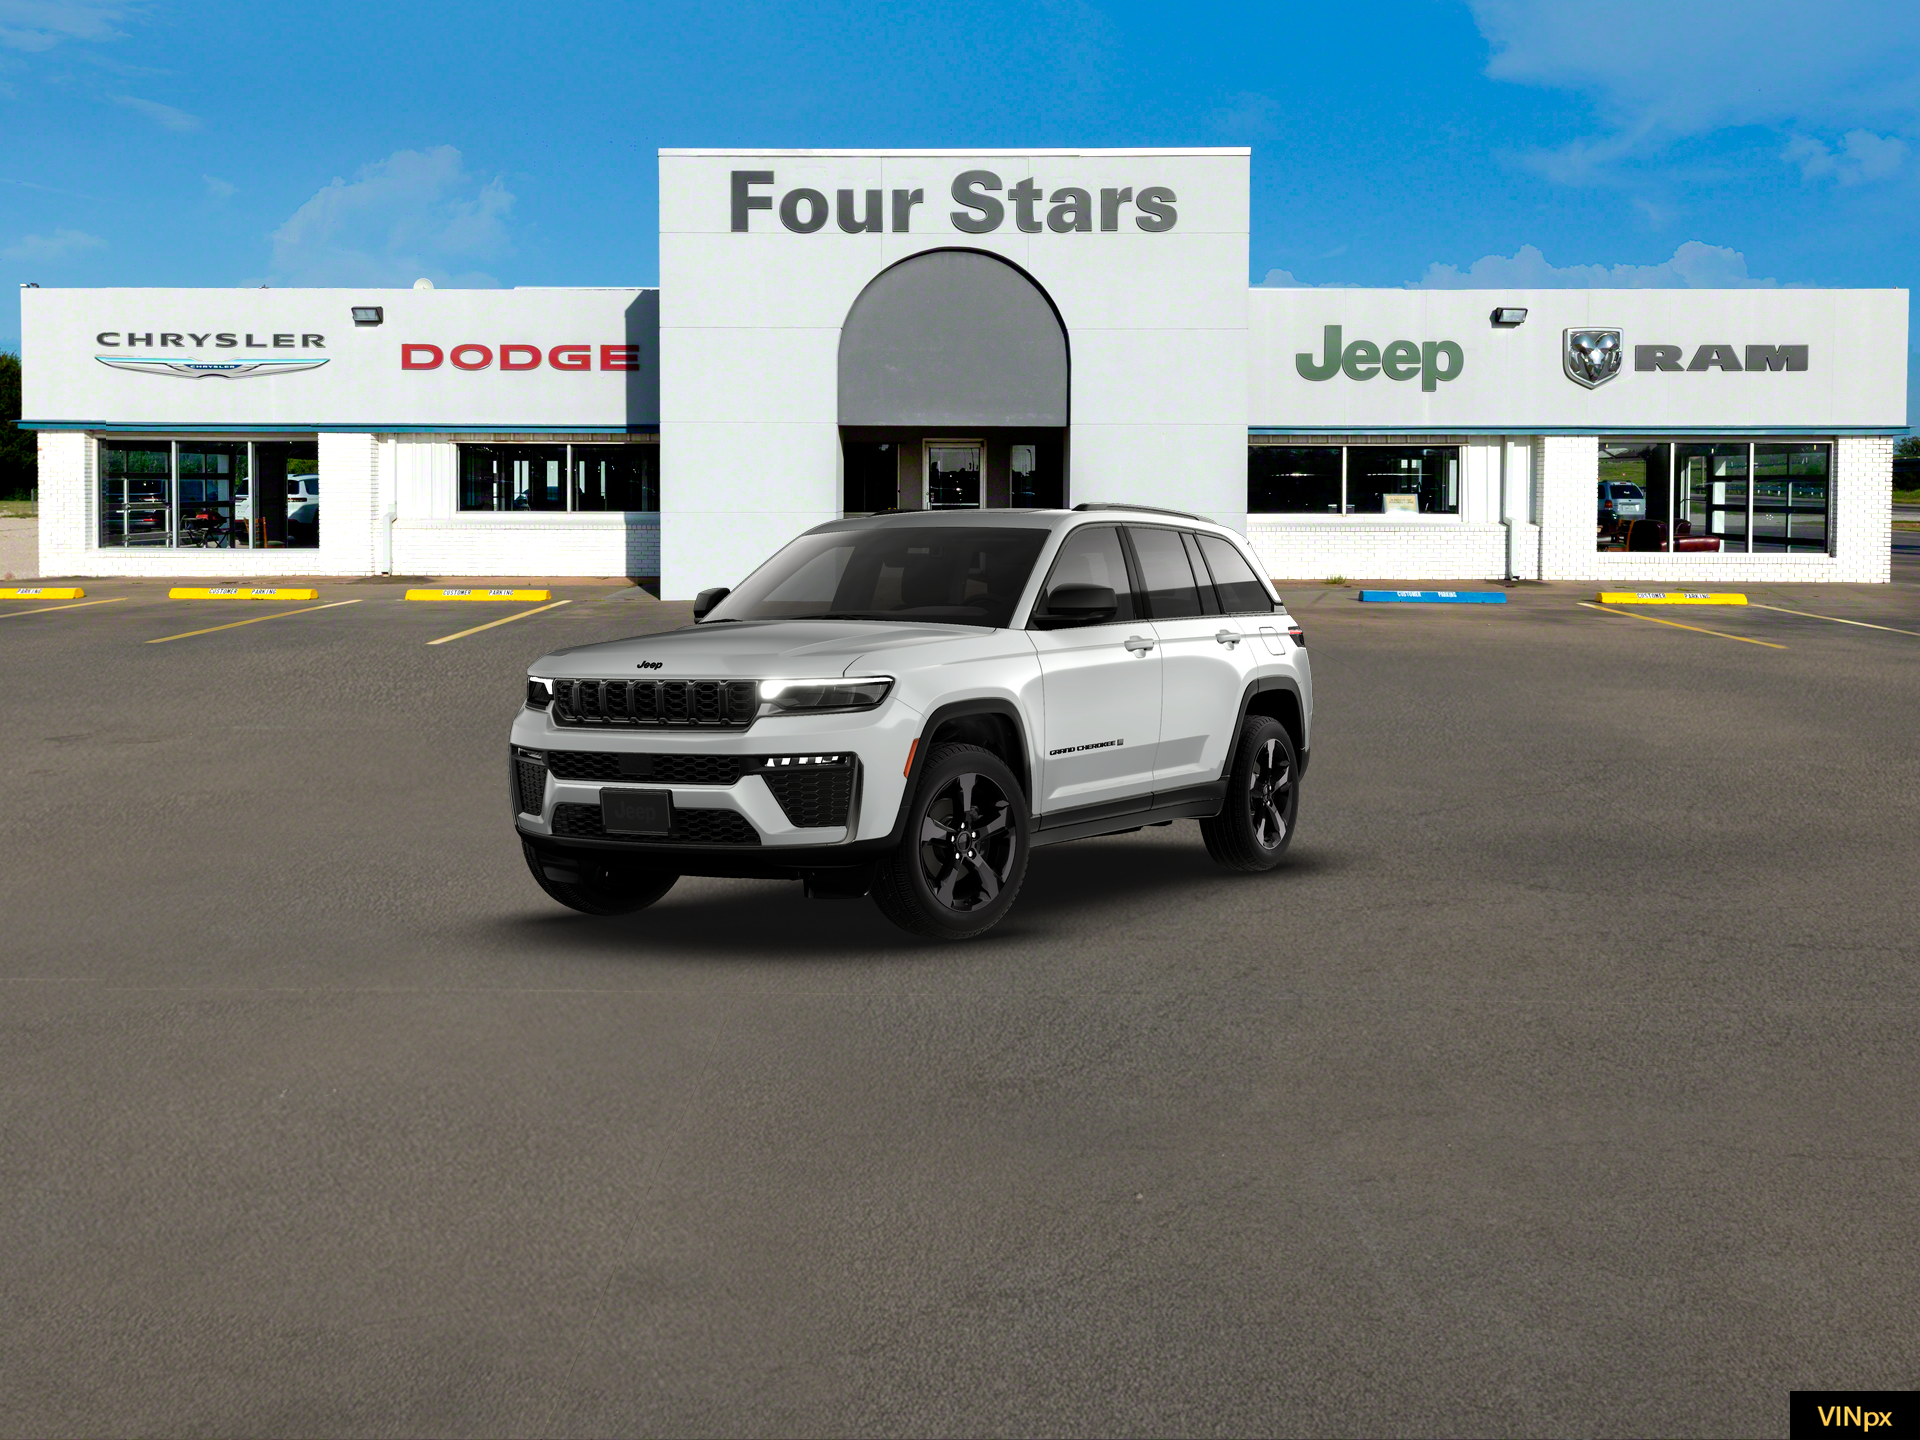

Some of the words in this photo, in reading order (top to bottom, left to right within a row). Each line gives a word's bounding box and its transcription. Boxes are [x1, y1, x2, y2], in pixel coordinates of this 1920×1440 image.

[730, 169, 924, 233] Four
[949, 168, 1178, 234] Stars
[96, 331, 326, 349] CHRYSLER
[401, 343, 640, 372] DODGE
[1296, 324, 1464, 392] Jeep
[1634, 344, 1809, 372] RAM
[637, 660, 663, 670] Jeep
[1049, 746, 1075, 756] GRAND
[1077, 740, 1116, 751] CHEROKEE
[614, 799, 656, 824] Jeep
